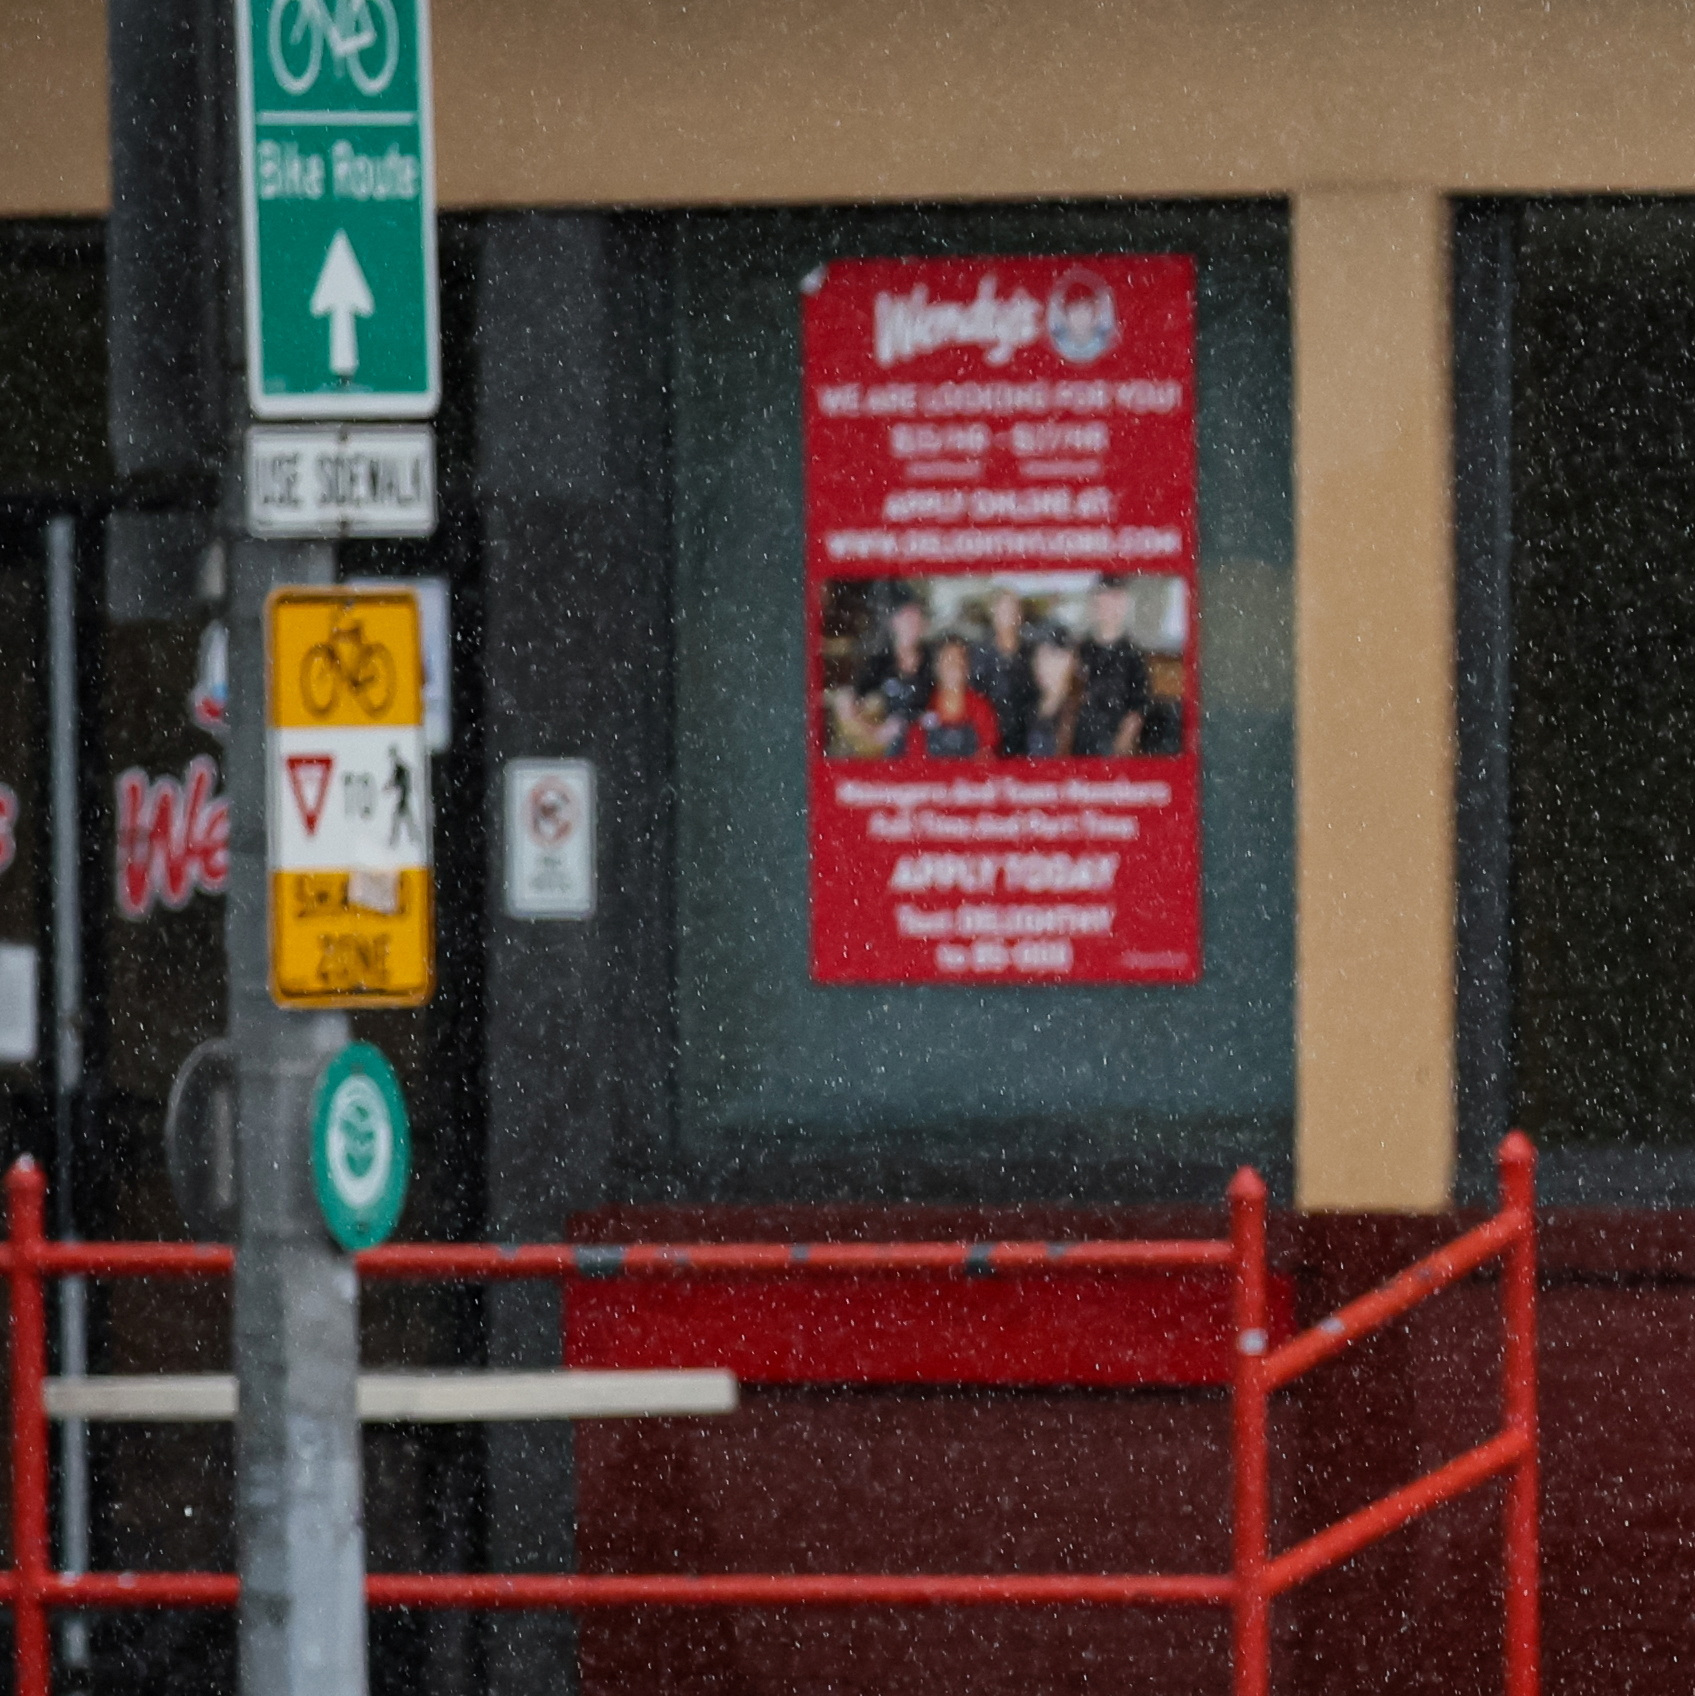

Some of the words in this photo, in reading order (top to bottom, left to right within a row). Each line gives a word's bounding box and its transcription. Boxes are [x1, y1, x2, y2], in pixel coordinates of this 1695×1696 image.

[257, 140, 325, 199] Bike
[332, 140, 421, 200] Route
[872, 272, 1041, 368] Wendy's
[891, 854, 998, 892] APPLY
[1003, 853, 1120, 892] TODAY
